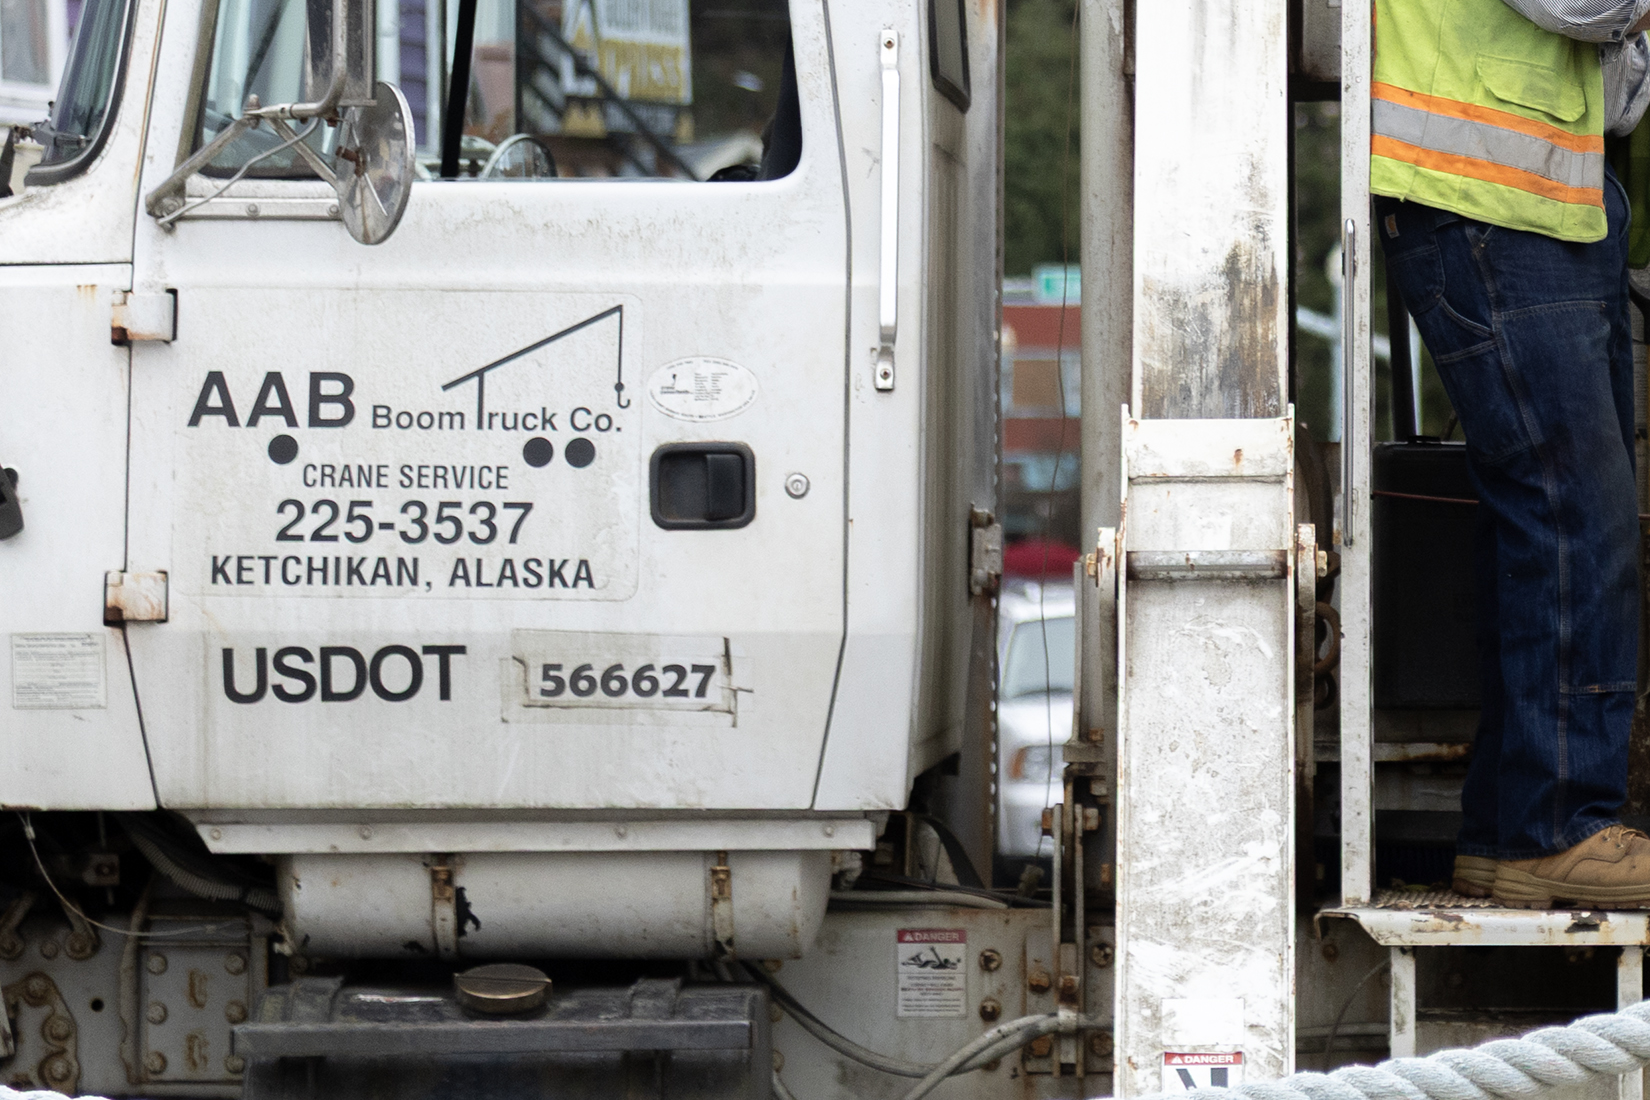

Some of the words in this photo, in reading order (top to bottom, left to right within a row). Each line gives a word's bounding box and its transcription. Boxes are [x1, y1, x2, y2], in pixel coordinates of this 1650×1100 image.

[187, 370, 356, 429] AAB
[370, 405, 465, 431] Boom
[570, 406, 623, 433] Co.
[302, 464, 390, 490] CRANE
[399, 465, 510, 491] SERVICE
[275, 500, 534, 545] 225-3537
[210, 555, 434, 593] KETCHIKAN,
[448, 558, 596, 590] ALASKA
[221, 644, 467, 705] USDOT
[538, 662, 717, 700] 566627
[914, 932, 960, 941] DANGER
[1184, 1055, 1234, 1064] DANGER
